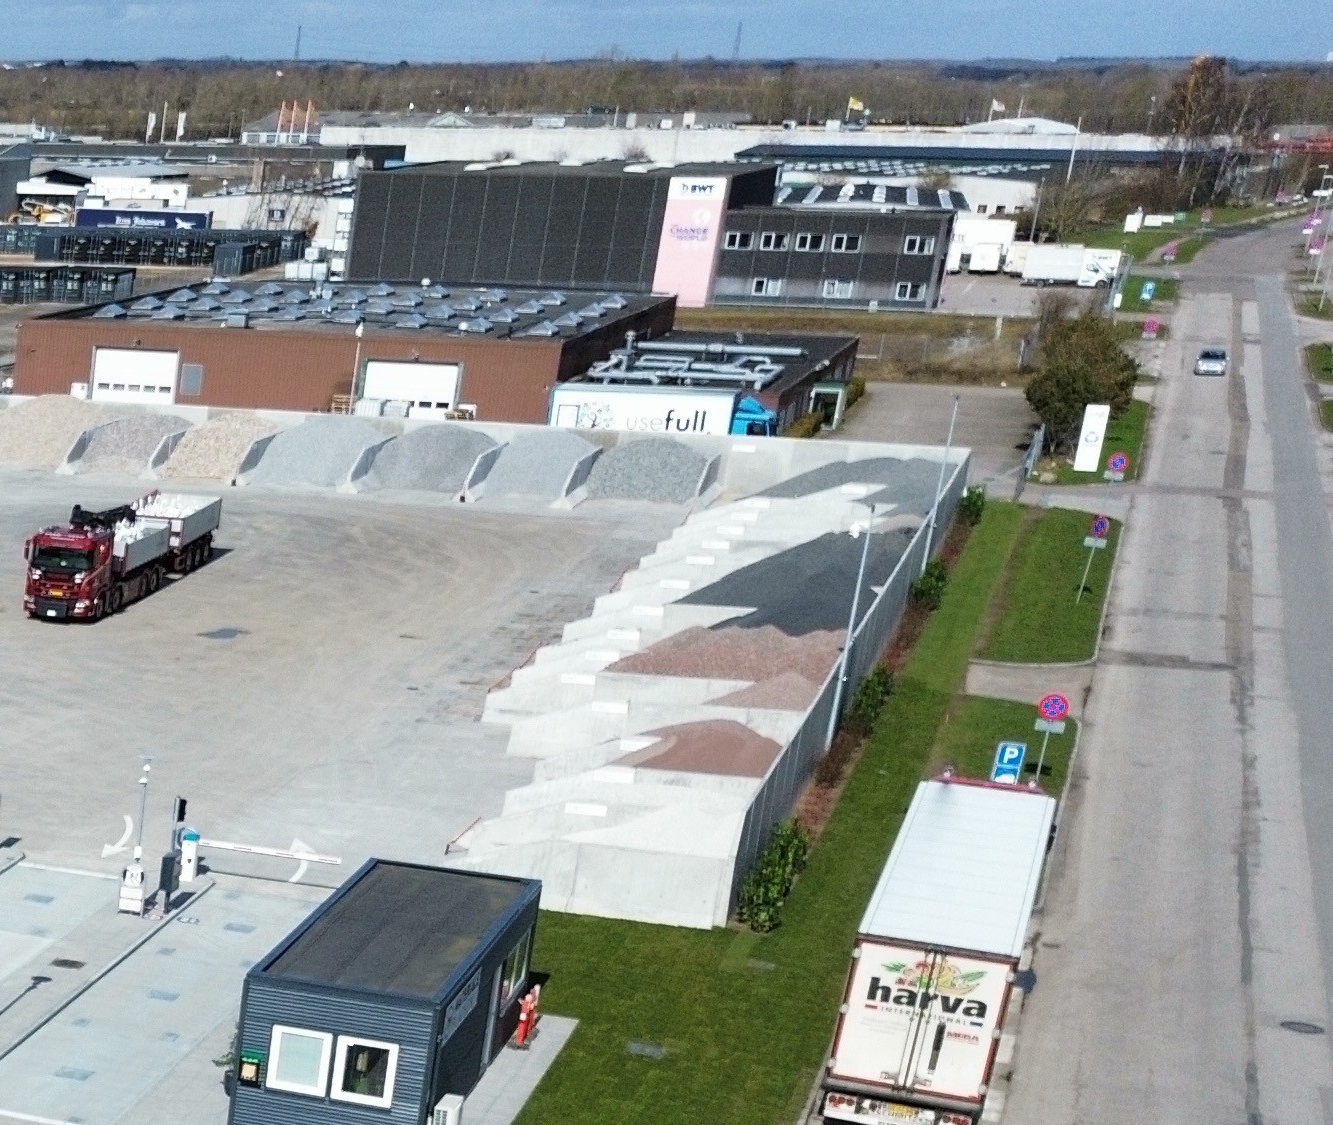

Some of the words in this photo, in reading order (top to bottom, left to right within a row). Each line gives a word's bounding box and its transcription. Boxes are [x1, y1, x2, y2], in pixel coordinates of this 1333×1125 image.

[626, 409, 707, 432] usefull
[1003, 747, 1019, 764] P
[866, 976, 988, 1018] harva
